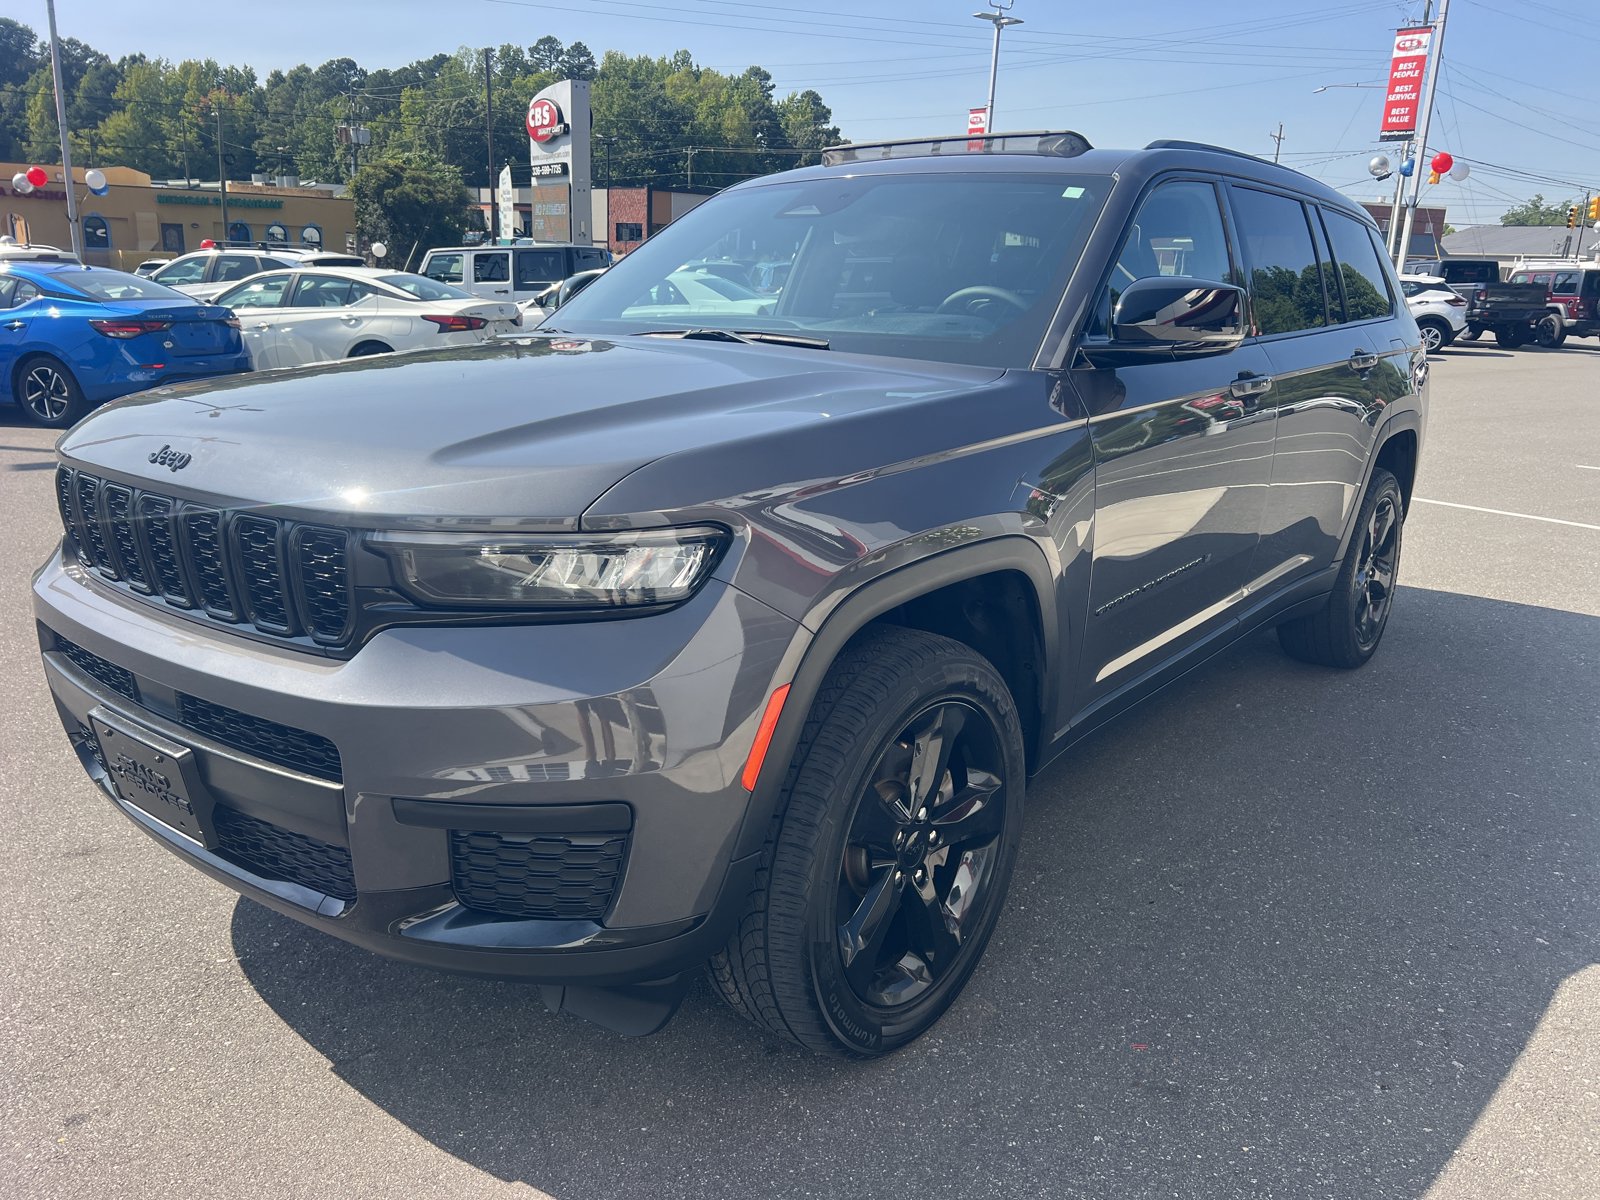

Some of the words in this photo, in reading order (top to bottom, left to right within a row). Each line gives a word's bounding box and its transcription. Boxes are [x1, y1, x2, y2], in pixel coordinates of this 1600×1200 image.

[1398, 62, 1417, 70] BEST
[1393, 70, 1420, 78] PEOPLE
[1394, 85, 1413, 93] BEST
[1388, 93, 1417, 102] SERVICE
[1391, 107, 1410, 115] BEST
[528, 104, 551, 128] CBS
[148, 444, 192, 473] Jeep
[829, 992, 878, 1047] Kunimoto
